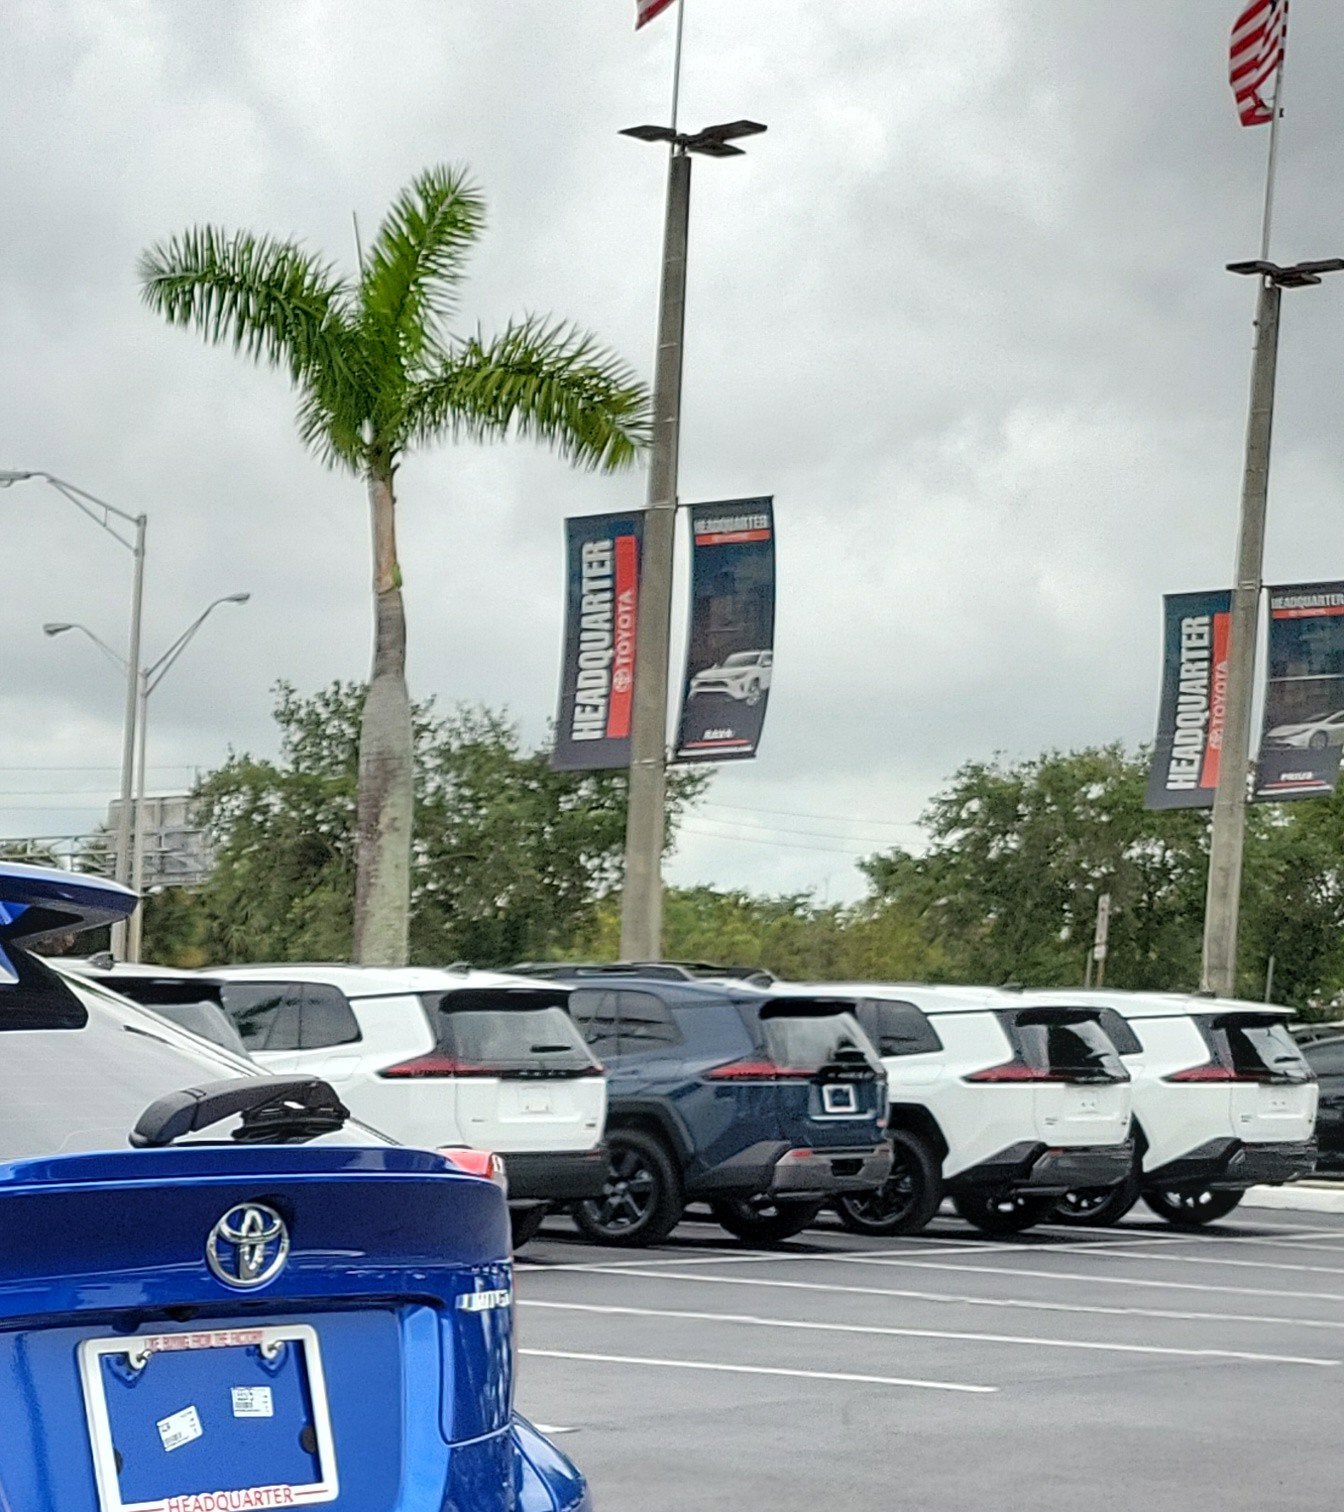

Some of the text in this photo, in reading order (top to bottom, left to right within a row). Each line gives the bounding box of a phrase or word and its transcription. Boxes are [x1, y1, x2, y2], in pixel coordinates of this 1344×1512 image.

[571, 538, 615, 742] HEADQUARTER
[615, 590, 635, 666] TOYOTA
[1165, 614, 1211, 790] HEADQUARTER
